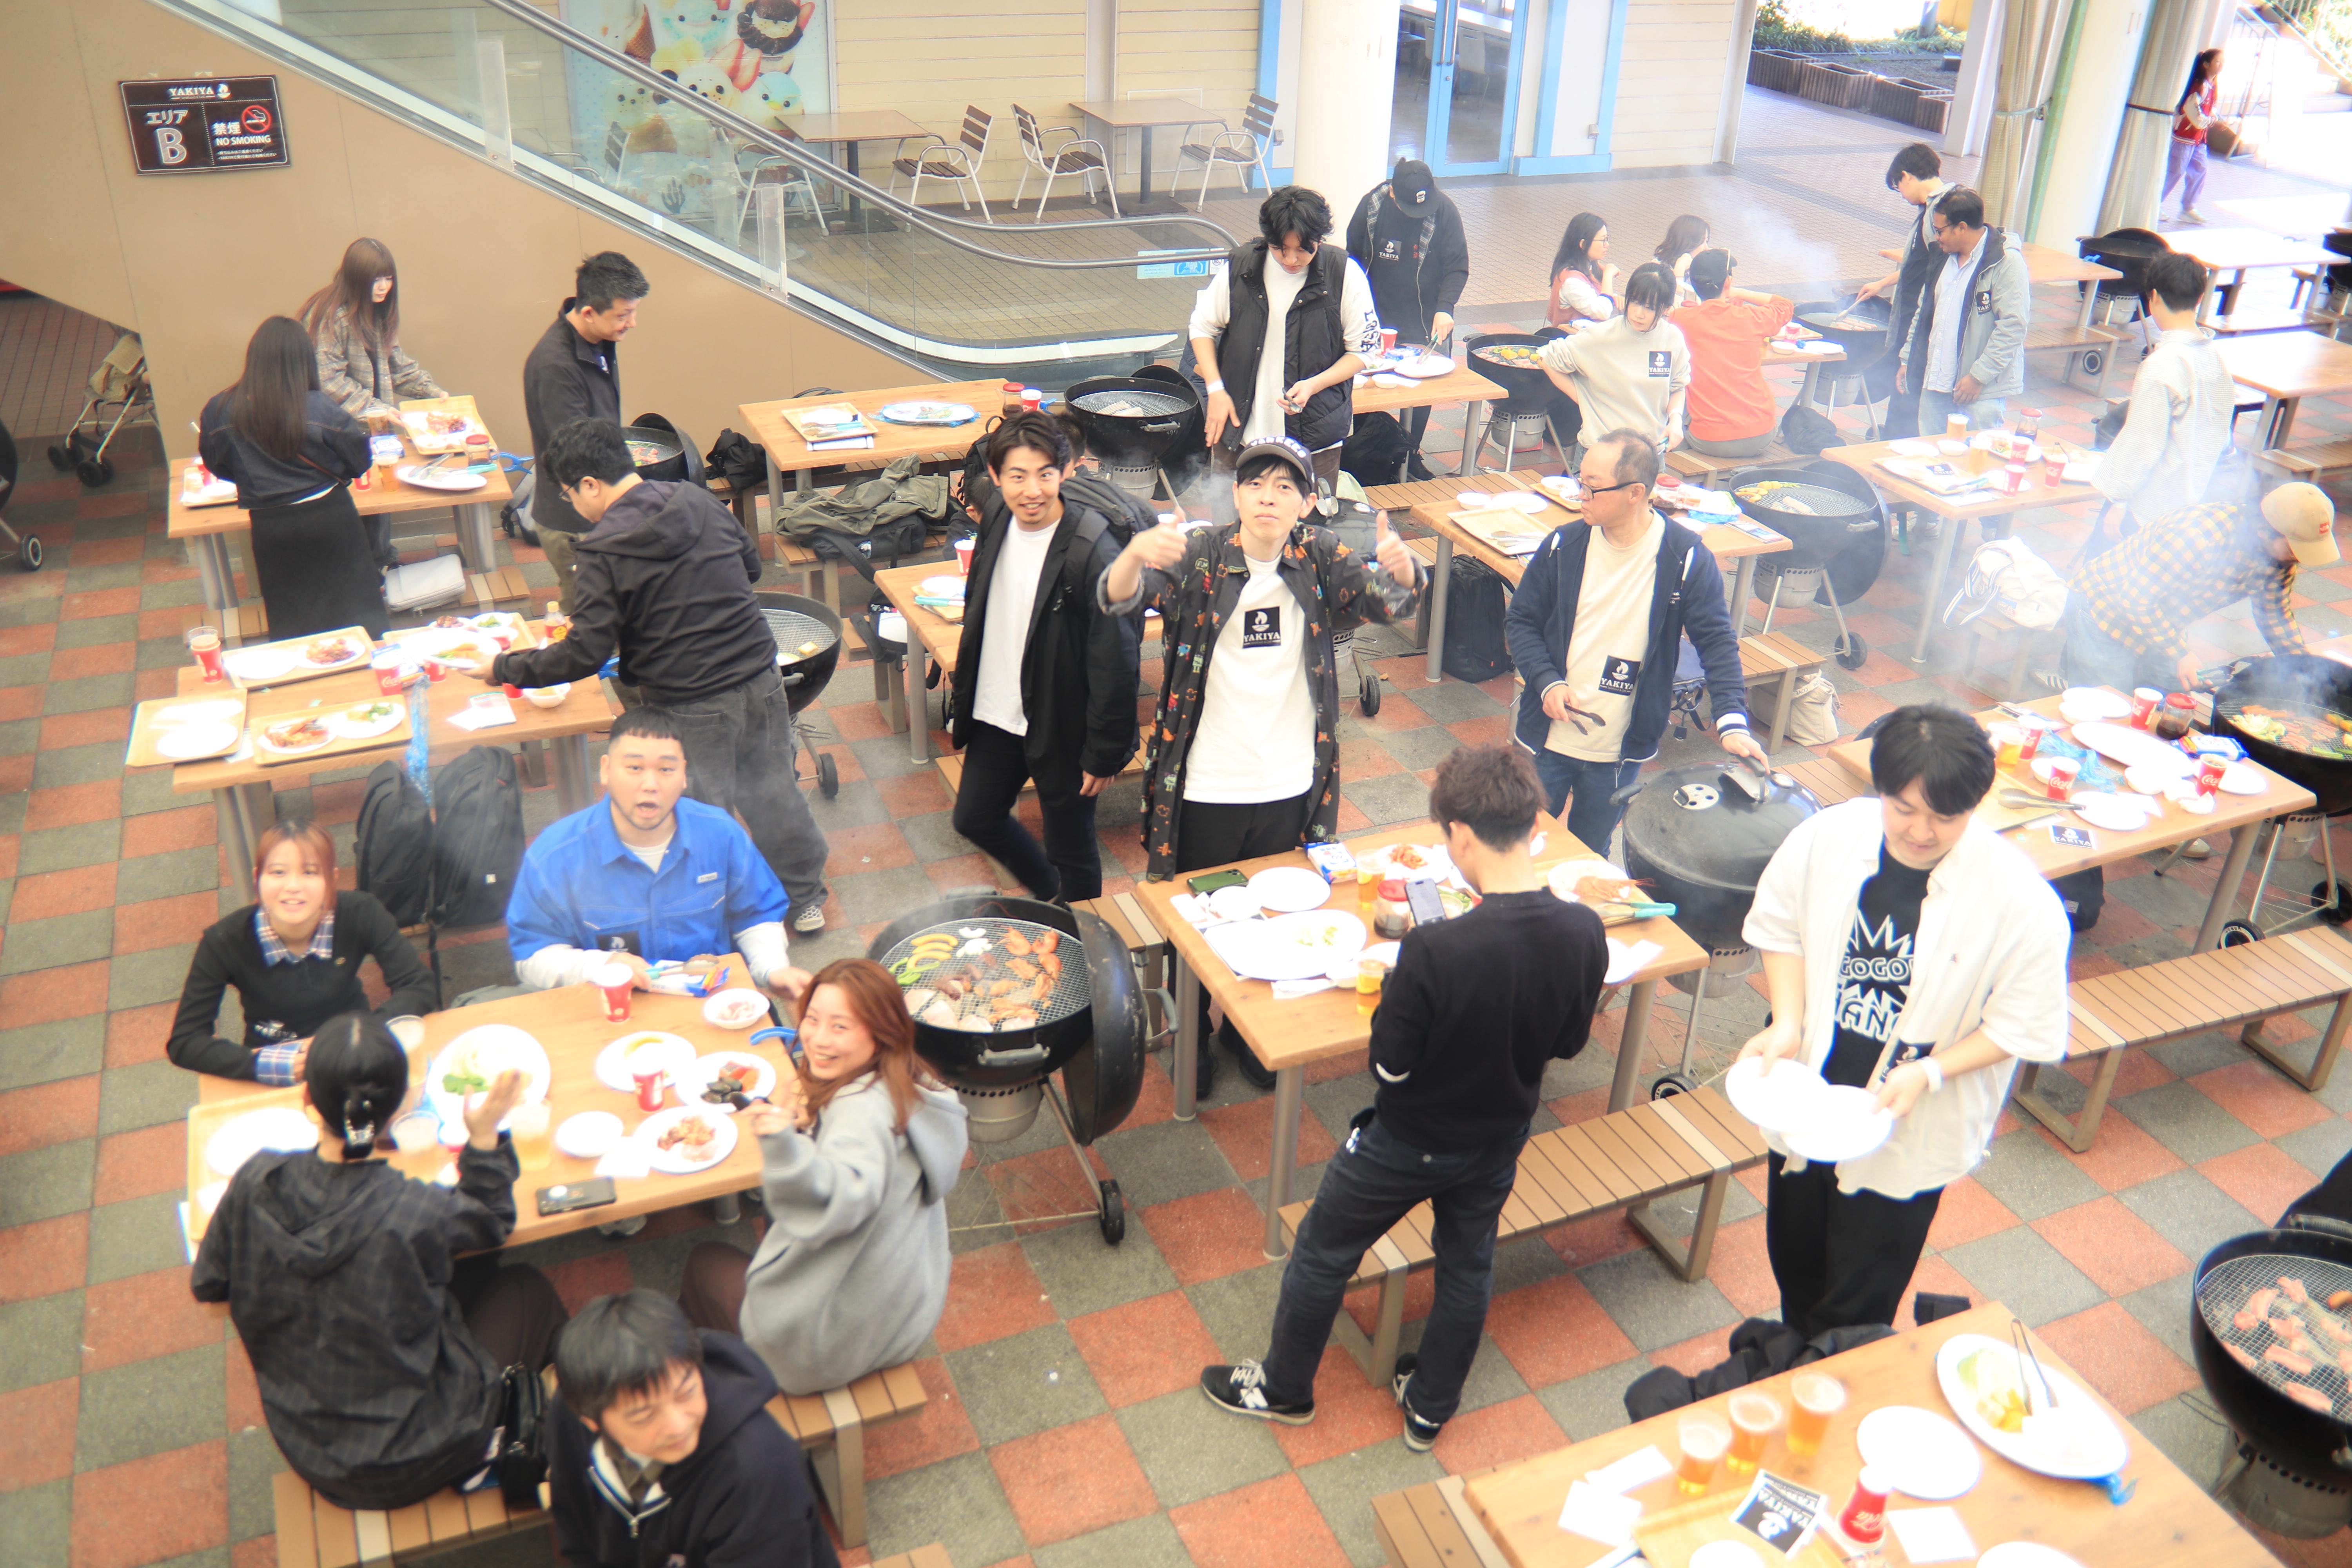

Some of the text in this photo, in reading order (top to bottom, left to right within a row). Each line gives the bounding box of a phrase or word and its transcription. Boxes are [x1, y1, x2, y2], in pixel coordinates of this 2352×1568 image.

[169, 87, 214, 96] YAKIYA
[147, 110, 188, 124] エリア
[212, 122, 241, 135] 禁煙
[156, 128, 187, 163] B
[216, 135, 271, 146] NO SMOKING
[1244, 632, 1280, 642] YAKIYA
[1601, 677, 1633, 690] YAKIYA
[2054, 836, 2091, 845] YAKIYA
[1758, 1490, 1809, 1529] YAKIYA
